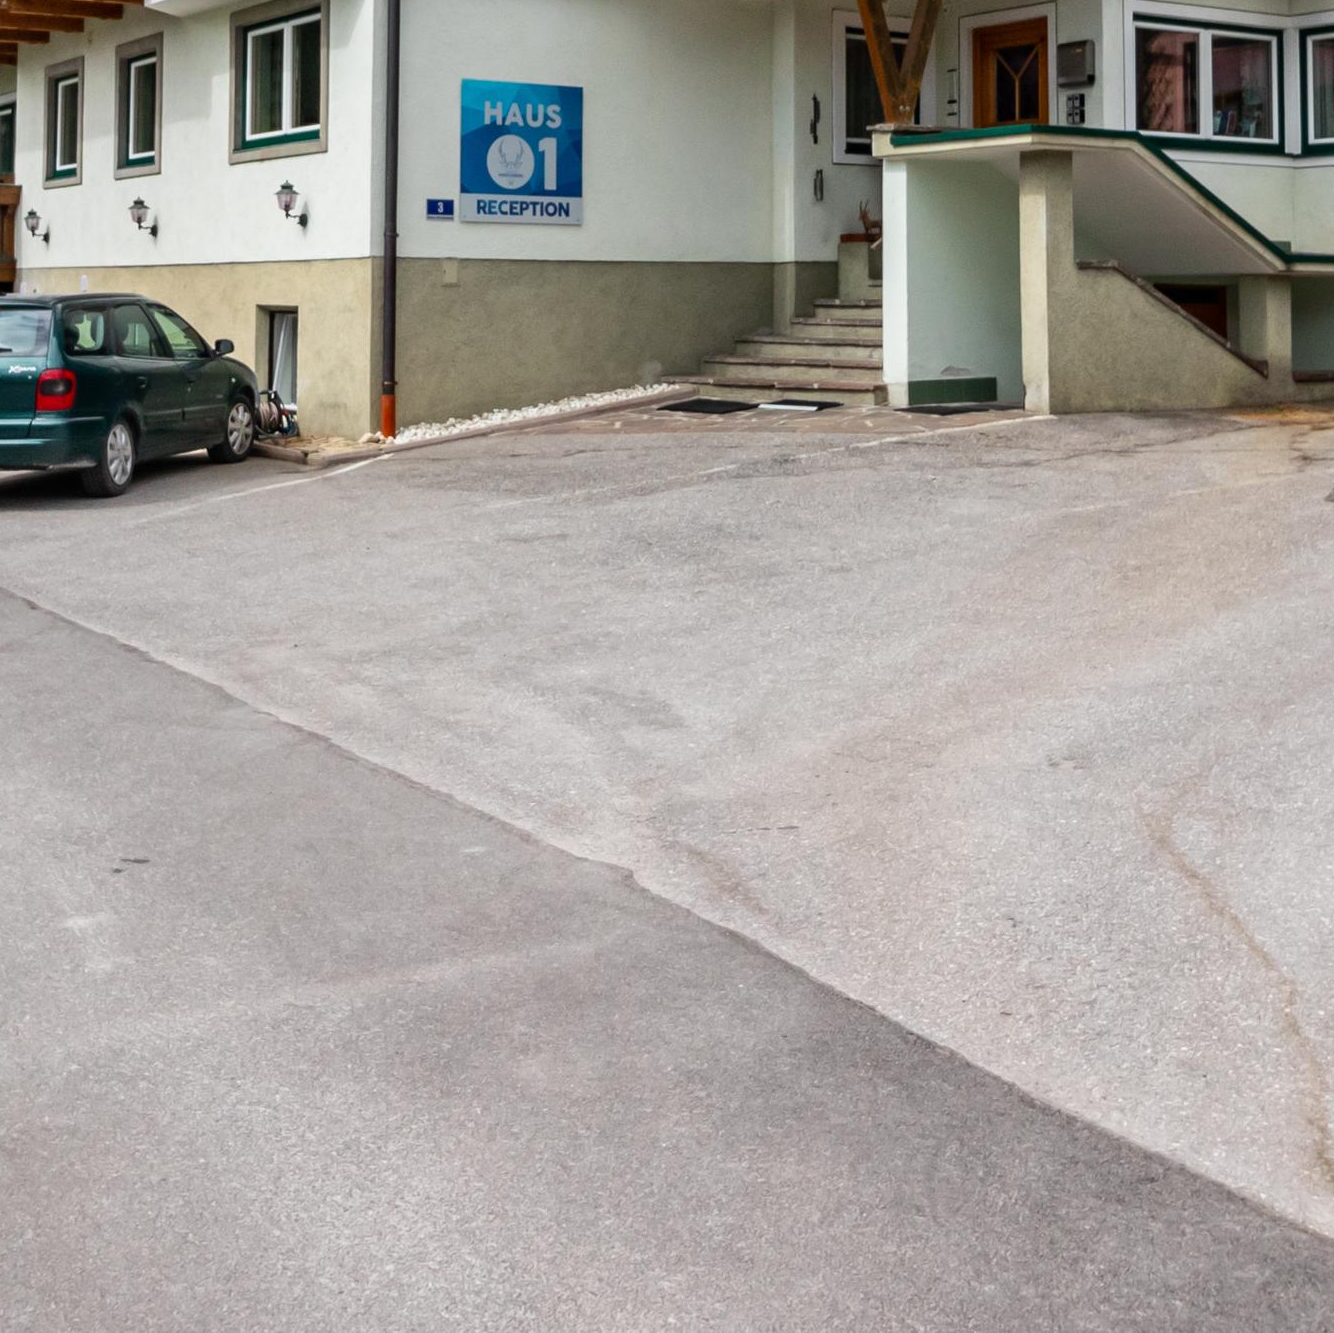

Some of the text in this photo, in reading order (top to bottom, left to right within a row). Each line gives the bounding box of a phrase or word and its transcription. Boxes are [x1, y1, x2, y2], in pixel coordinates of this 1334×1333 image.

[484, 100, 563, 129] HAUS
[437, 202, 444, 213] 3
[476, 199, 571, 218] RECEPTION
